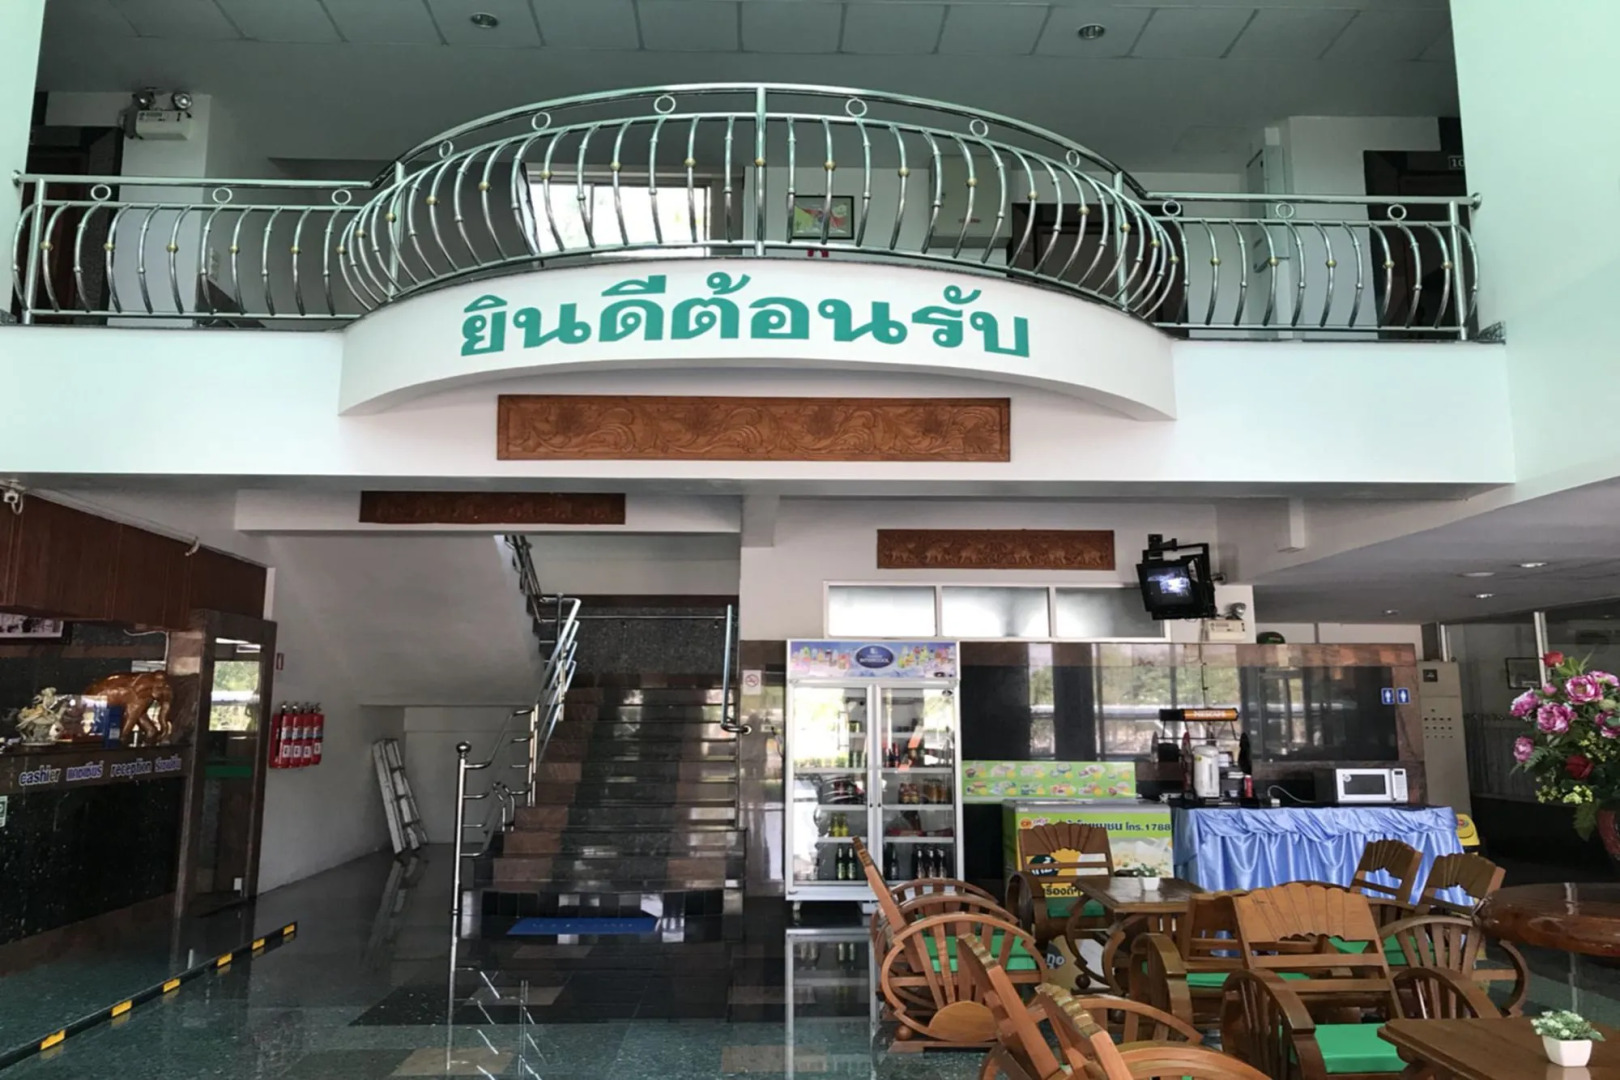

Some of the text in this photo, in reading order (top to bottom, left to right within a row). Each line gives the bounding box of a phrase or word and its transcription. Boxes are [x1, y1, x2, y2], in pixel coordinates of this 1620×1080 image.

[461, 272, 1030, 357] ยินดีต้อนรับ
